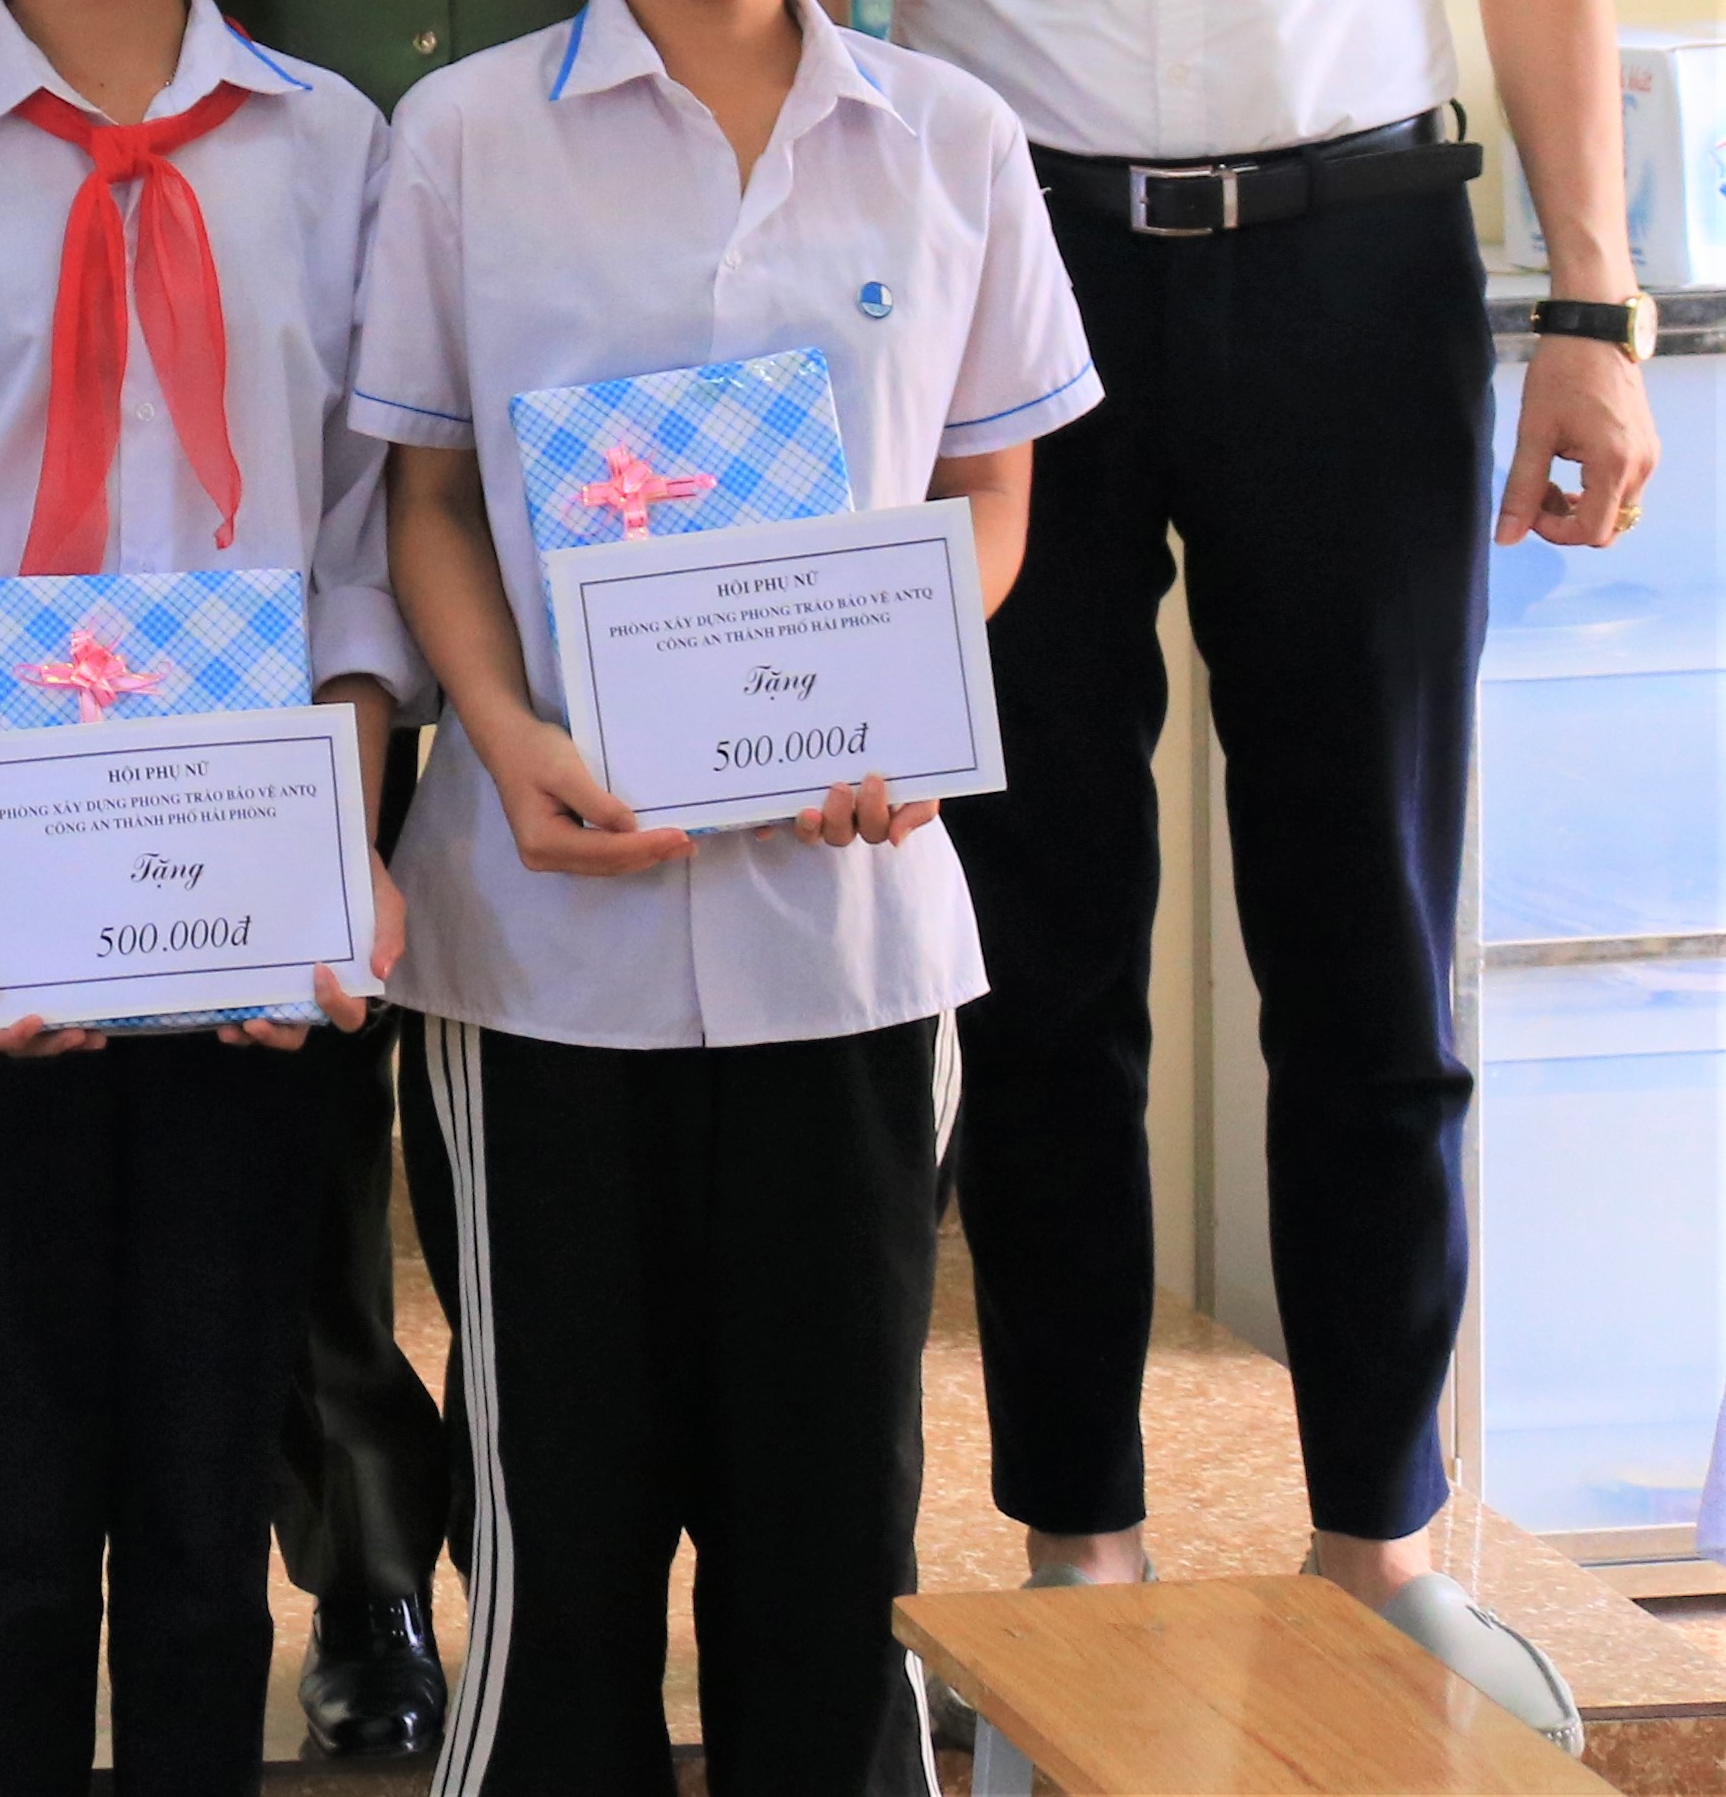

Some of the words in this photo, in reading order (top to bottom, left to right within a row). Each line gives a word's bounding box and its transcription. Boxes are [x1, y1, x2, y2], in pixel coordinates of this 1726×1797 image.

[716, 579, 750, 598] HỘI
[753, 575, 788, 592] PHỤ
[793, 570, 818, 587] NỮ
[609, 621, 660, 638] PHÒNG
[663, 616, 692, 631] XÂY
[740, 605, 791, 621] PHONG
[894, 587, 933, 602] ANTQ
[656, 636, 698, 652] CÔNG
[702, 633, 722, 645] AN
[776, 621, 808, 637] PHỐ
[840, 611, 890, 628] PHÒNG
[743, 665, 817, 701] Tặng
[713, 722, 869, 771] 500.000đ
[107, 765, 140, 784] HỘI
[145, 764, 179, 781] PHỤ
[184, 760, 209, 776] NỮ
[52, 800, 81, 815] XÂY
[130, 793, 181, 808] PHONG
[280, 783, 317, 797] ANTQ
[44, 820, 86, 835] CÔNG
[90, 819, 110, 831] AN
[167, 808, 198, 825] PHỐ
[228, 805, 276, 820] PHÒNG
[130, 852, 204, 890] Tặng
[96, 914, 251, 958] 500.000đ
